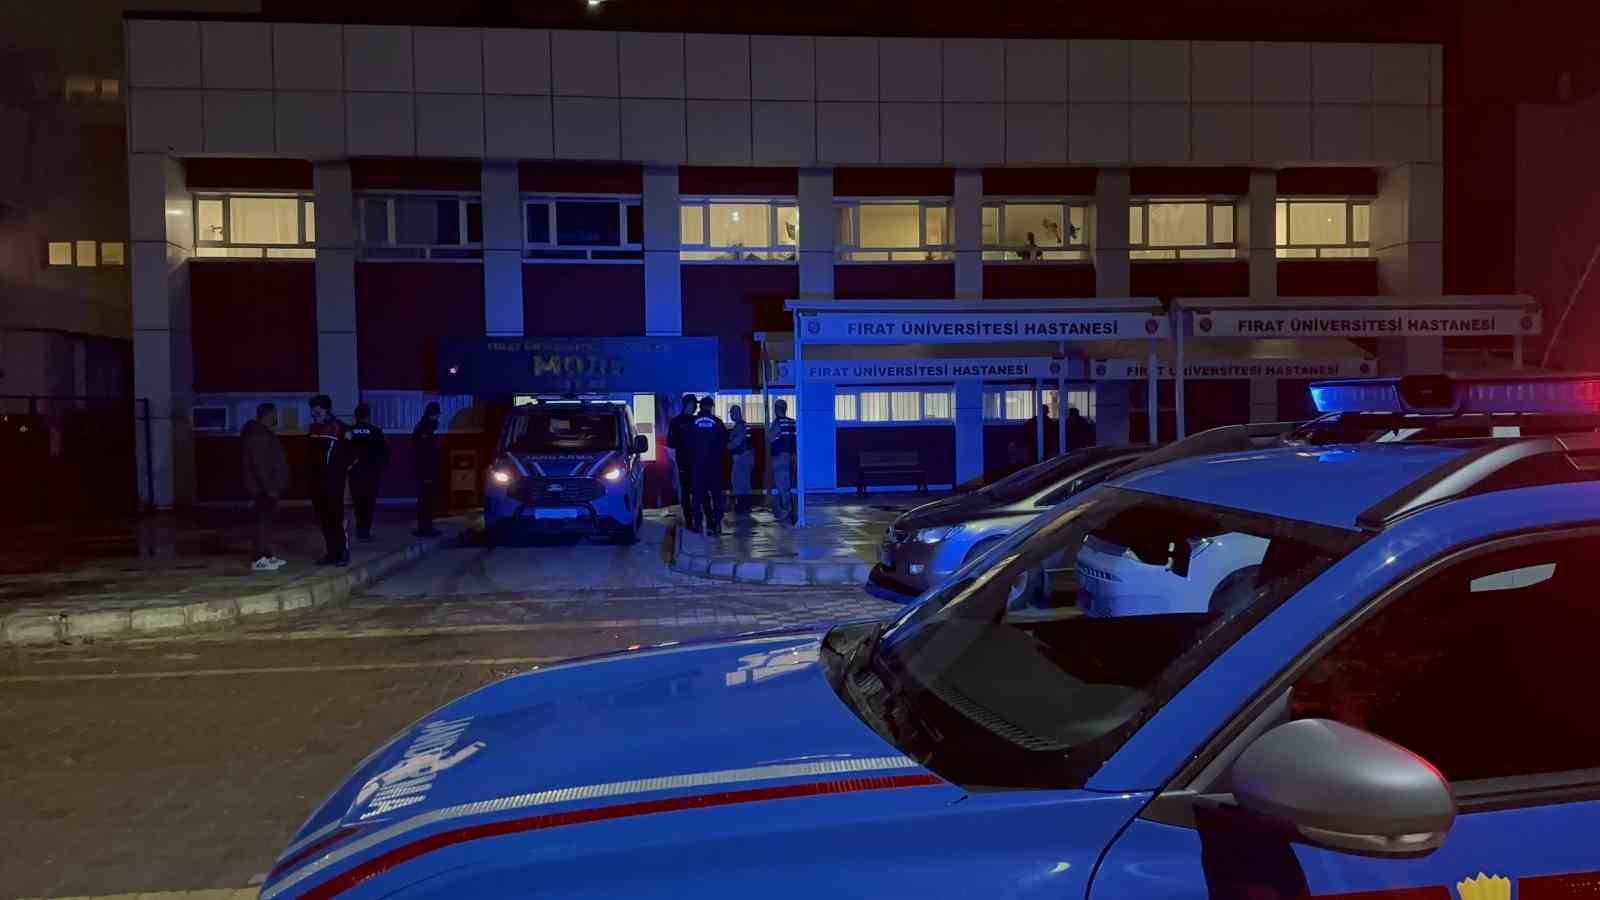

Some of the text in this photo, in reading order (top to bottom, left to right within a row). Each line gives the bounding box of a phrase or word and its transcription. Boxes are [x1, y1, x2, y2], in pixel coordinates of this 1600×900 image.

[847, 320, 1118, 335] FIRAT ÜNİVERSİTESİ HASTANESİ
[1238, 318, 1496, 332] FIRAT ÜNİVERSİTESİ HASTANESİ
[809, 366, 849, 377] FIRAT
[953, 364, 1028, 376] HASTANESİ
[1126, 365, 1165, 377] FIRT
